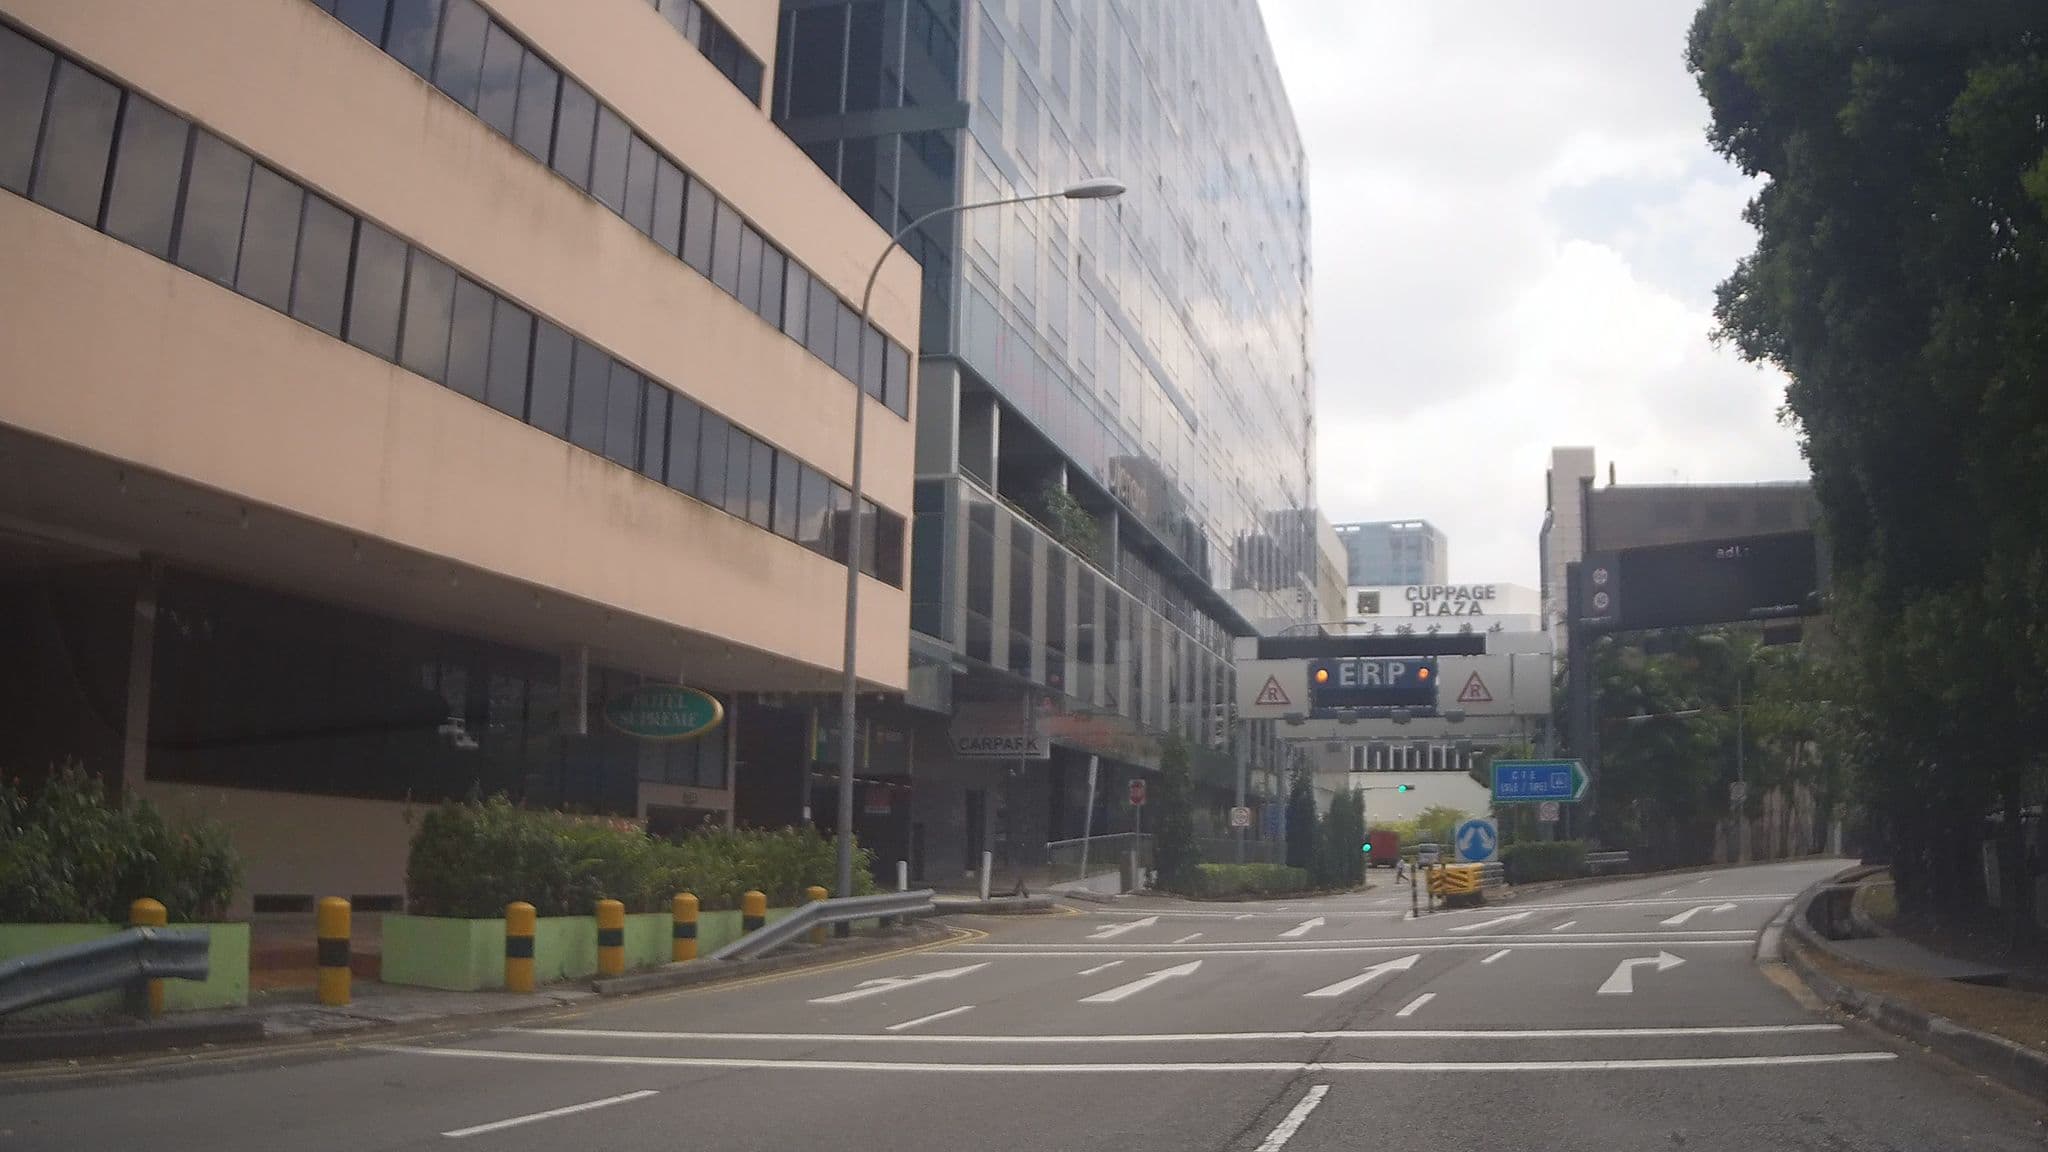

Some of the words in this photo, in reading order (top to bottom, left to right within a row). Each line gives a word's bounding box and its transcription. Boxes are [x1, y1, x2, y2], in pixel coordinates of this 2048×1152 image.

[1405, 584, 1496, 601] CUPPAGE
[1412, 601, 1484, 616] PLAZA
[1339, 662, 1405, 686] ERP
[960, 737, 1040, 750] CARPARK
